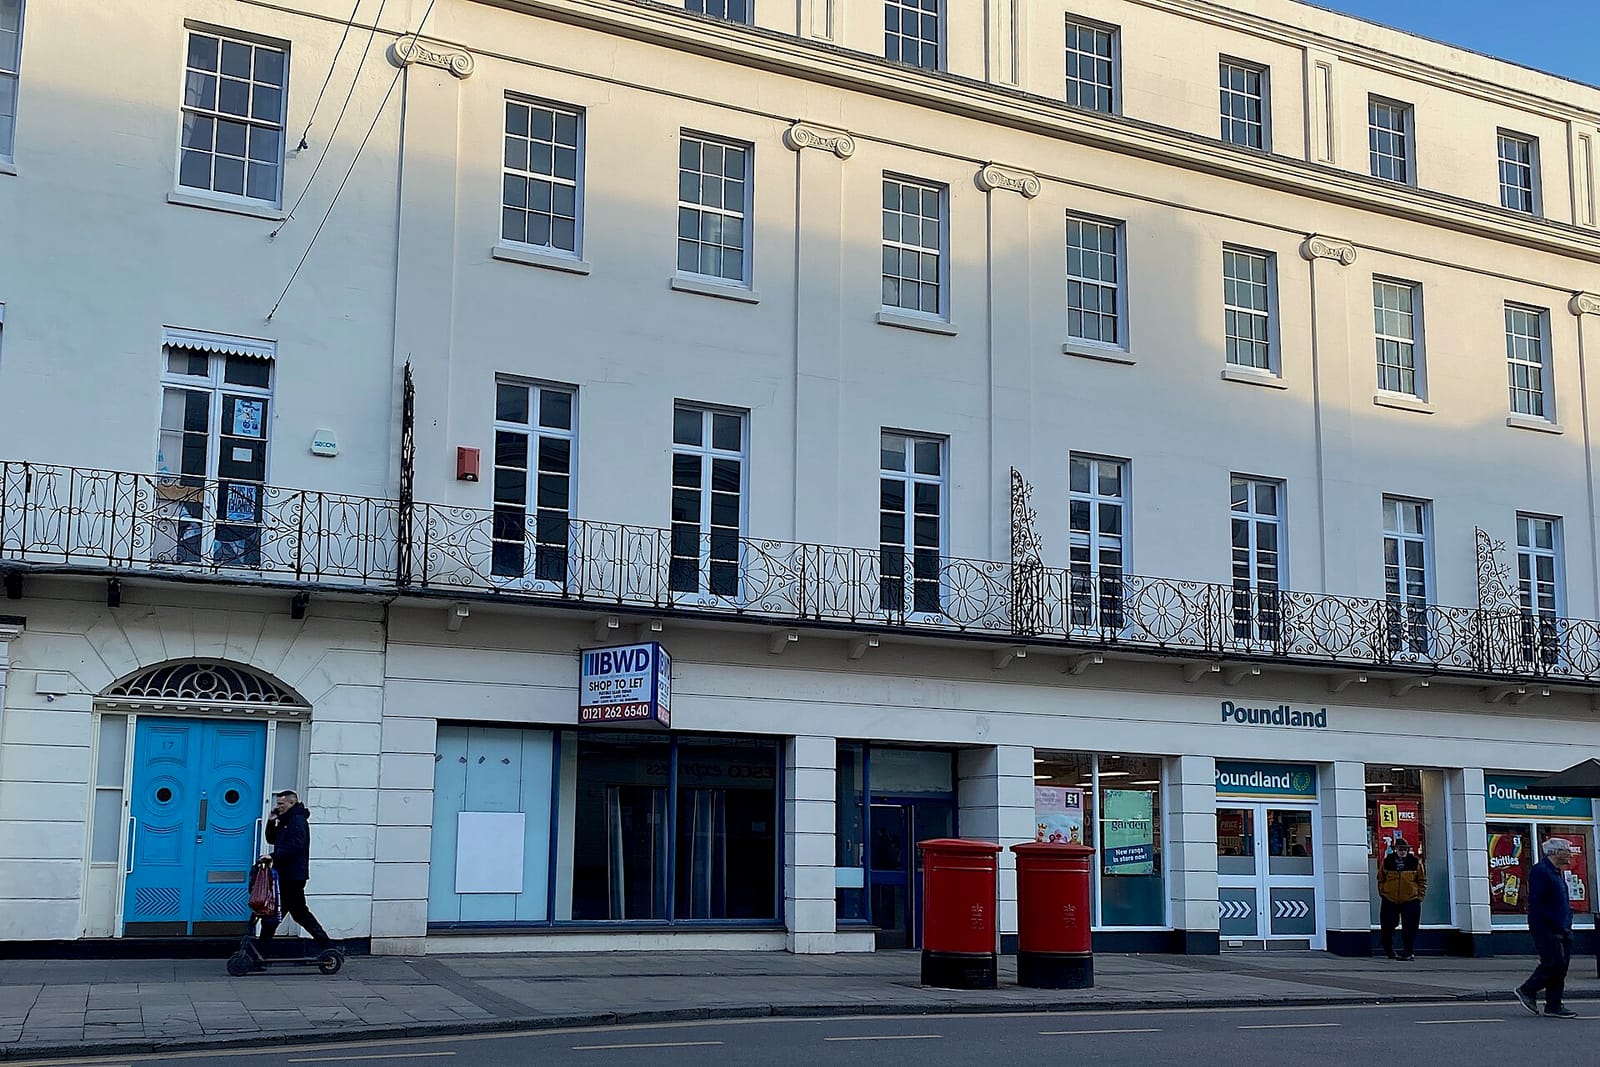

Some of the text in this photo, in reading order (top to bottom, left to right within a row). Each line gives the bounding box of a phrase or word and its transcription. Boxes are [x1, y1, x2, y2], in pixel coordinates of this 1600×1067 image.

[589, 677, 644, 691] SHOP TO LET
[582, 704, 649, 720] 0121 262 6540
[1221, 701, 1328, 728] Poundland
[1067, 794, 1077, 804] £1
[1383, 810, 1415, 822] £1 PRICE
[1111, 817, 1147, 831] garden
[1128, 847, 1144, 855] range
[1134, 853, 1147, 861] now!
[1490, 855, 1520, 868] Skittles
